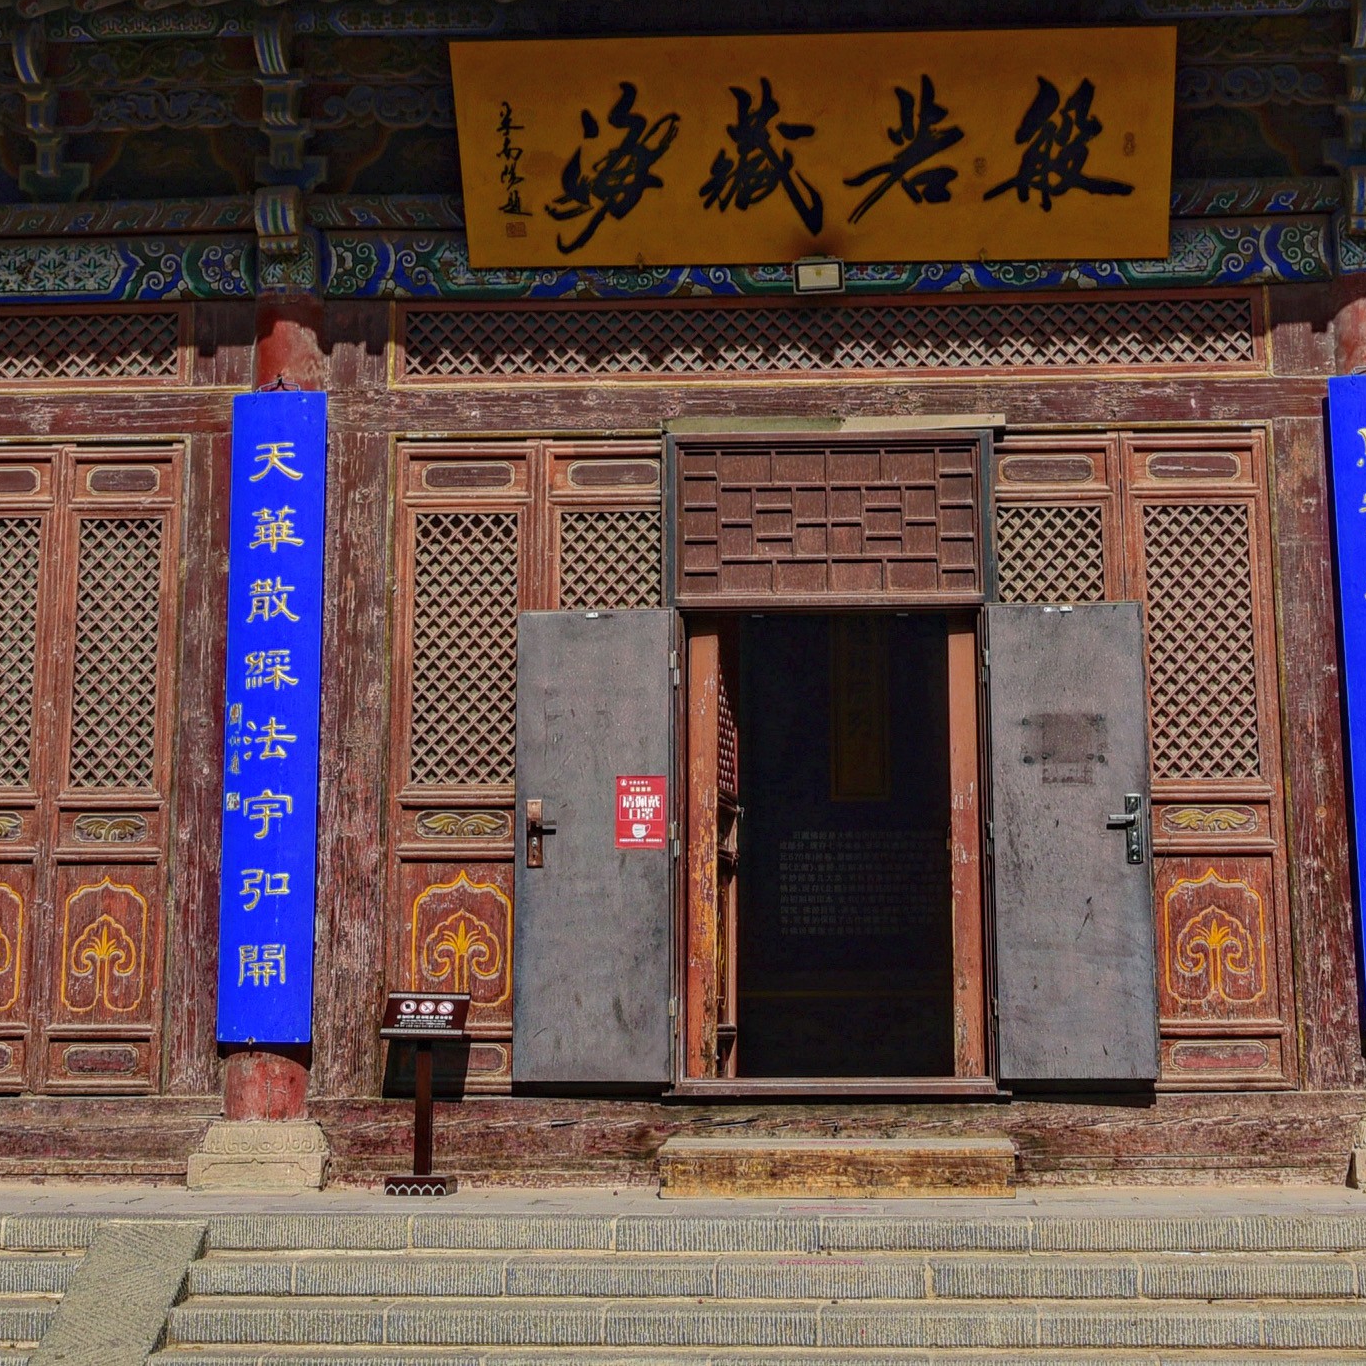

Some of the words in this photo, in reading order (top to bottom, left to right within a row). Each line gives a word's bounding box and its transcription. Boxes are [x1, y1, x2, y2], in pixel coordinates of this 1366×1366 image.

[622, 795, 661, 808] 请佩戴
[628, 807, 654, 821] 口罩
